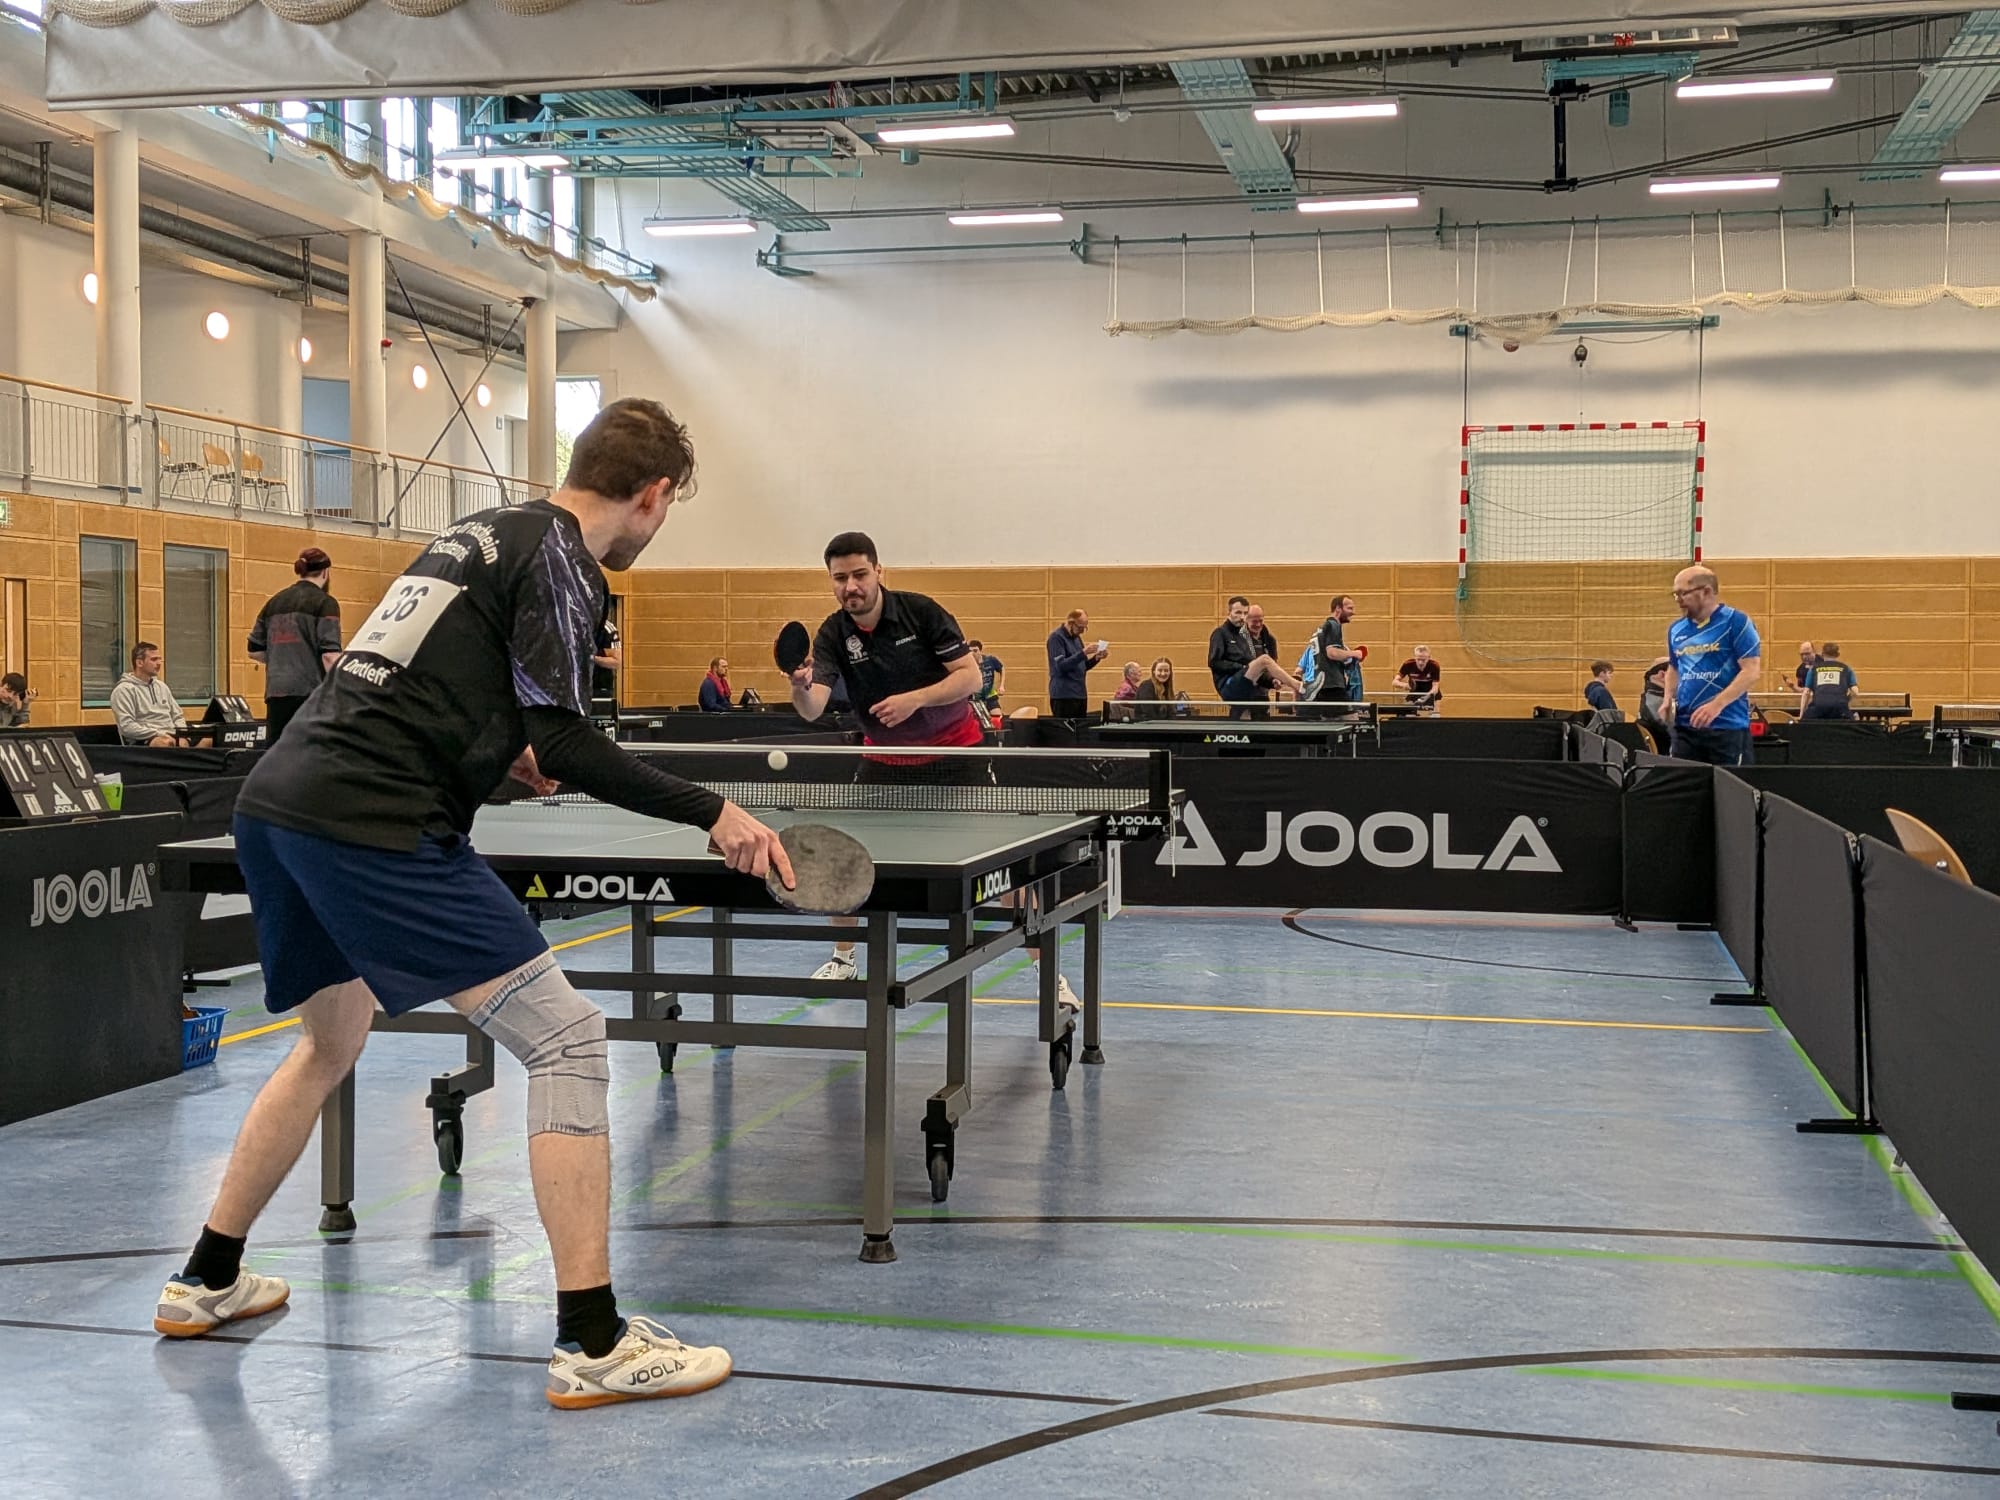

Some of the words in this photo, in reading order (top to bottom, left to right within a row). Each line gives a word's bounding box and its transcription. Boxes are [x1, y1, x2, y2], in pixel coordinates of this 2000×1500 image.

[381, 585, 429, 622] 36
[343, 658, 391, 686] Drotleff
[224, 732, 256, 743] DONIC
[1213, 735, 1250, 743] JOOLA
[0, 744, 30, 783] 11
[25, 744, 41, 766] 2
[42, 743, 56, 765] 1
[65, 742, 87, 780] 9
[54, 804, 81, 814] JOOLA
[1117, 815, 1162, 826] JOOLA
[553, 874, 675, 902] JOOLA
[983, 866, 1012, 898] JOOLA
[628, 1359, 686, 1386] JOOLA
